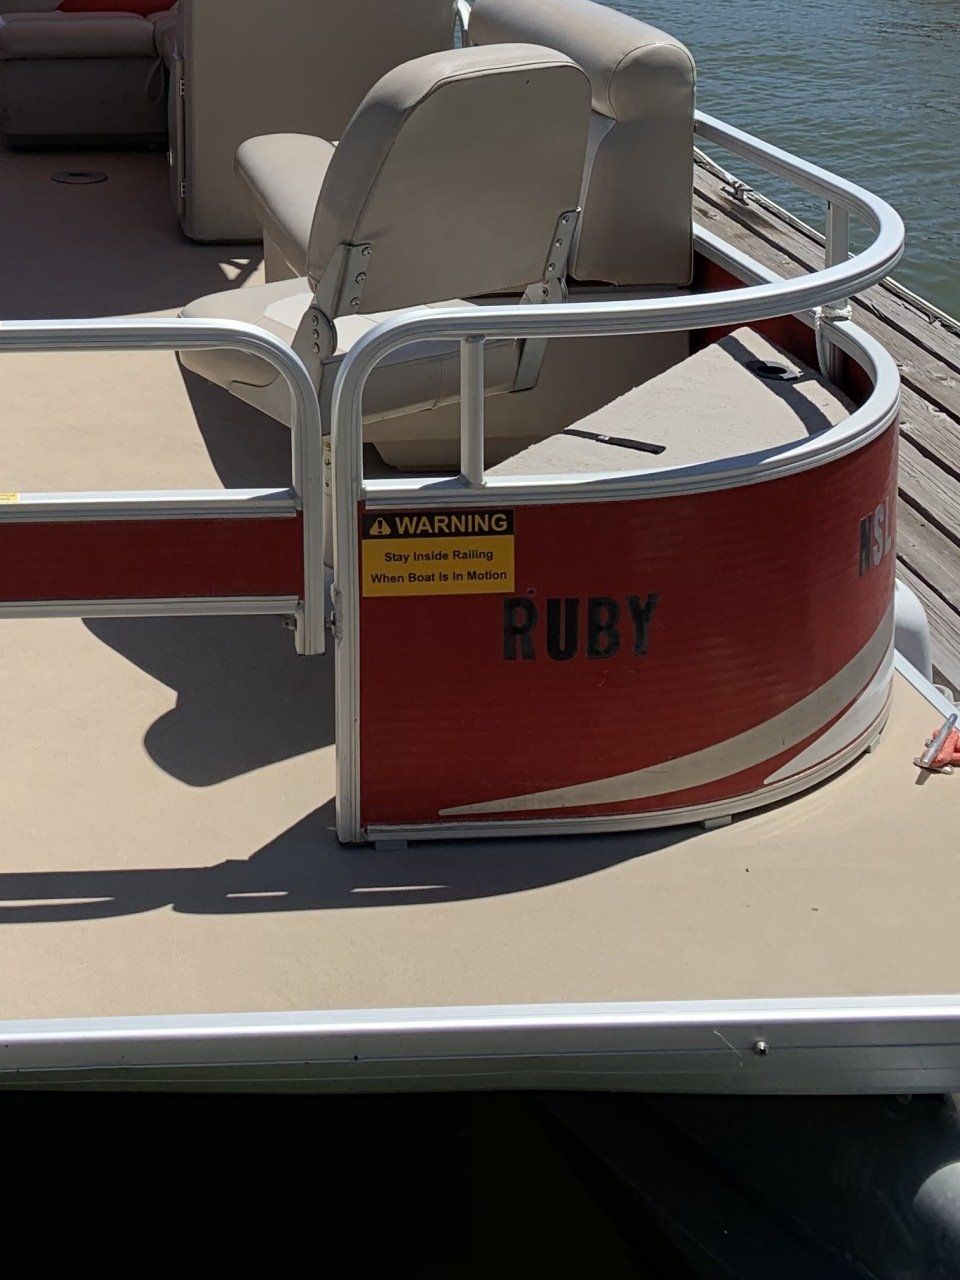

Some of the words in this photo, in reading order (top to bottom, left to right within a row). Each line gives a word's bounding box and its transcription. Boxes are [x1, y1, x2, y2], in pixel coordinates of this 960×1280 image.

[395, 513, 508, 535] WARNING
[384, 551, 410, 564] Stay
[413, 550, 449, 562] Inside
[452, 549, 494, 562] Railing
[371, 572, 404, 583] When
[408, 572, 435, 583] Boat
[439, 572, 449, 582] Is
[452, 571, 464, 581] In
[467, 570, 507, 581] Motion
[501, 592, 661, 662] RUBY
